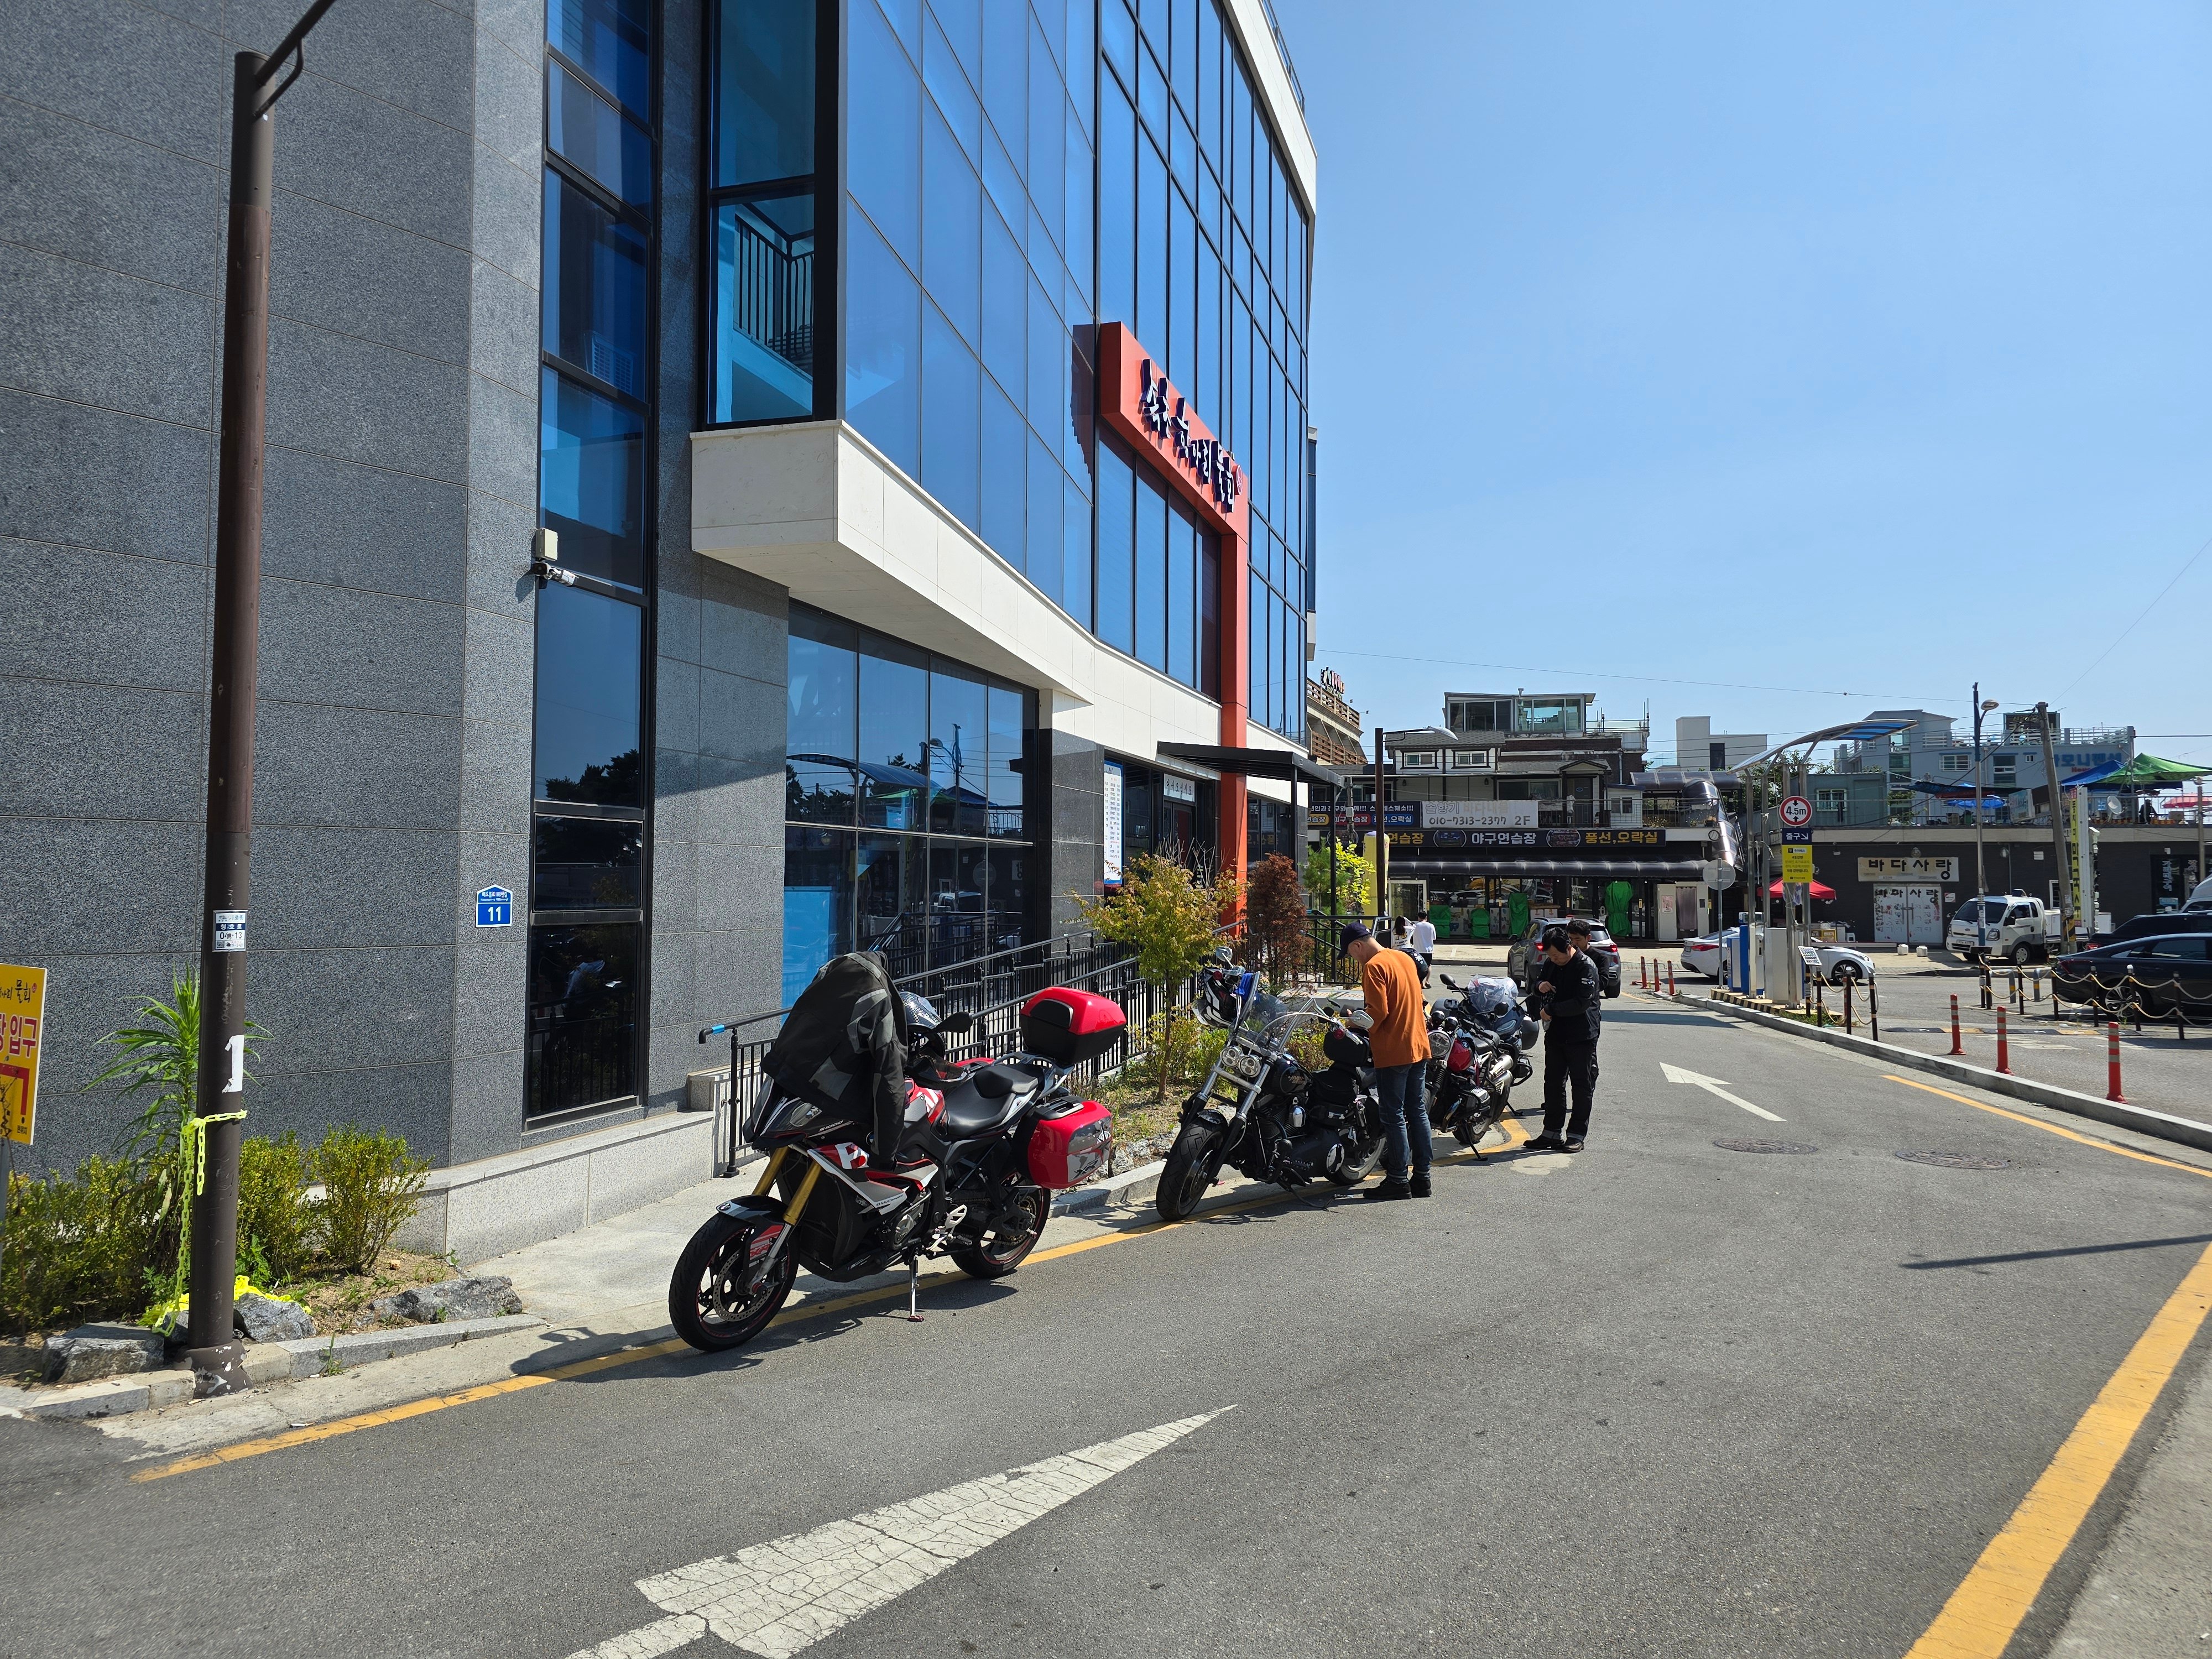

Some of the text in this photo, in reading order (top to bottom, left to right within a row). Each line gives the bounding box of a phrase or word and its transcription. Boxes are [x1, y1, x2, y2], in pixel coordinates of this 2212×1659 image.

[1426, 802, 1459, 814] 솔향기
[1786, 806, 1806, 815] 4.5m
[1514, 815, 1531, 825] 2F
[1472, 832, 1537, 844] 야구연습장
[1585, 832, 1646, 844] 풍선,오락실
[1869, 859, 1952, 880] 바다사랑
[488, 906, 501, 921] 11
[15, 979, 31, 1004] 물회
[818, 1120, 844, 1132] S1000
